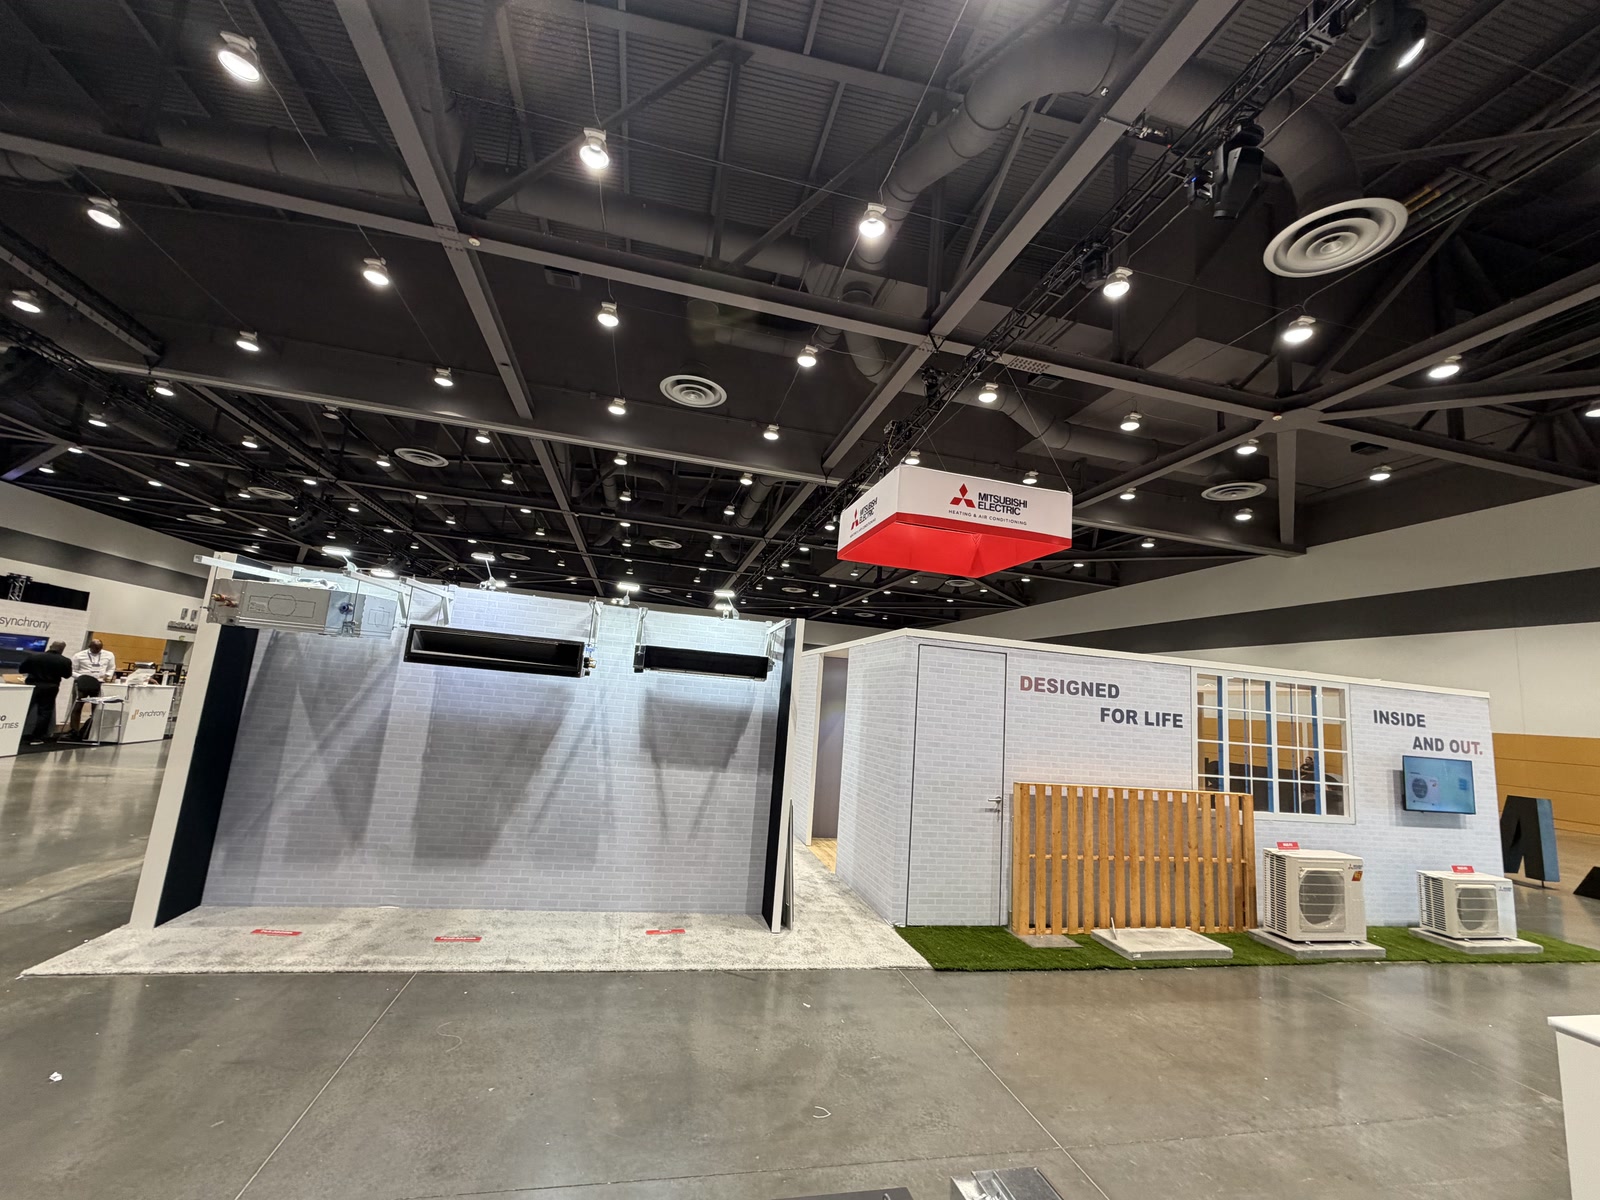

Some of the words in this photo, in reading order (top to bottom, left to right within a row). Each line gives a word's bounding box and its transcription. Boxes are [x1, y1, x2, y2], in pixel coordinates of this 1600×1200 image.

[977, 501, 1021, 516] ELECTRIC
[978, 492, 1028, 509] MITSUBISHI
[948, 509, 972, 517] HEATING
[989, 516, 1027, 526] CONDITIONING
[0, 616, 51, 631] synchrony
[1020, 675, 1120, 699] DESIGNED
[138, 709, 167, 718] synchrony
[1100, 707, 1138, 725] FOR
[1144, 711, 1183, 728] LIFE
[1373, 710, 1426, 728] INSIDE
[1412, 736, 1445, 752] AND
[1449, 739, 1483, 755] OUT.
